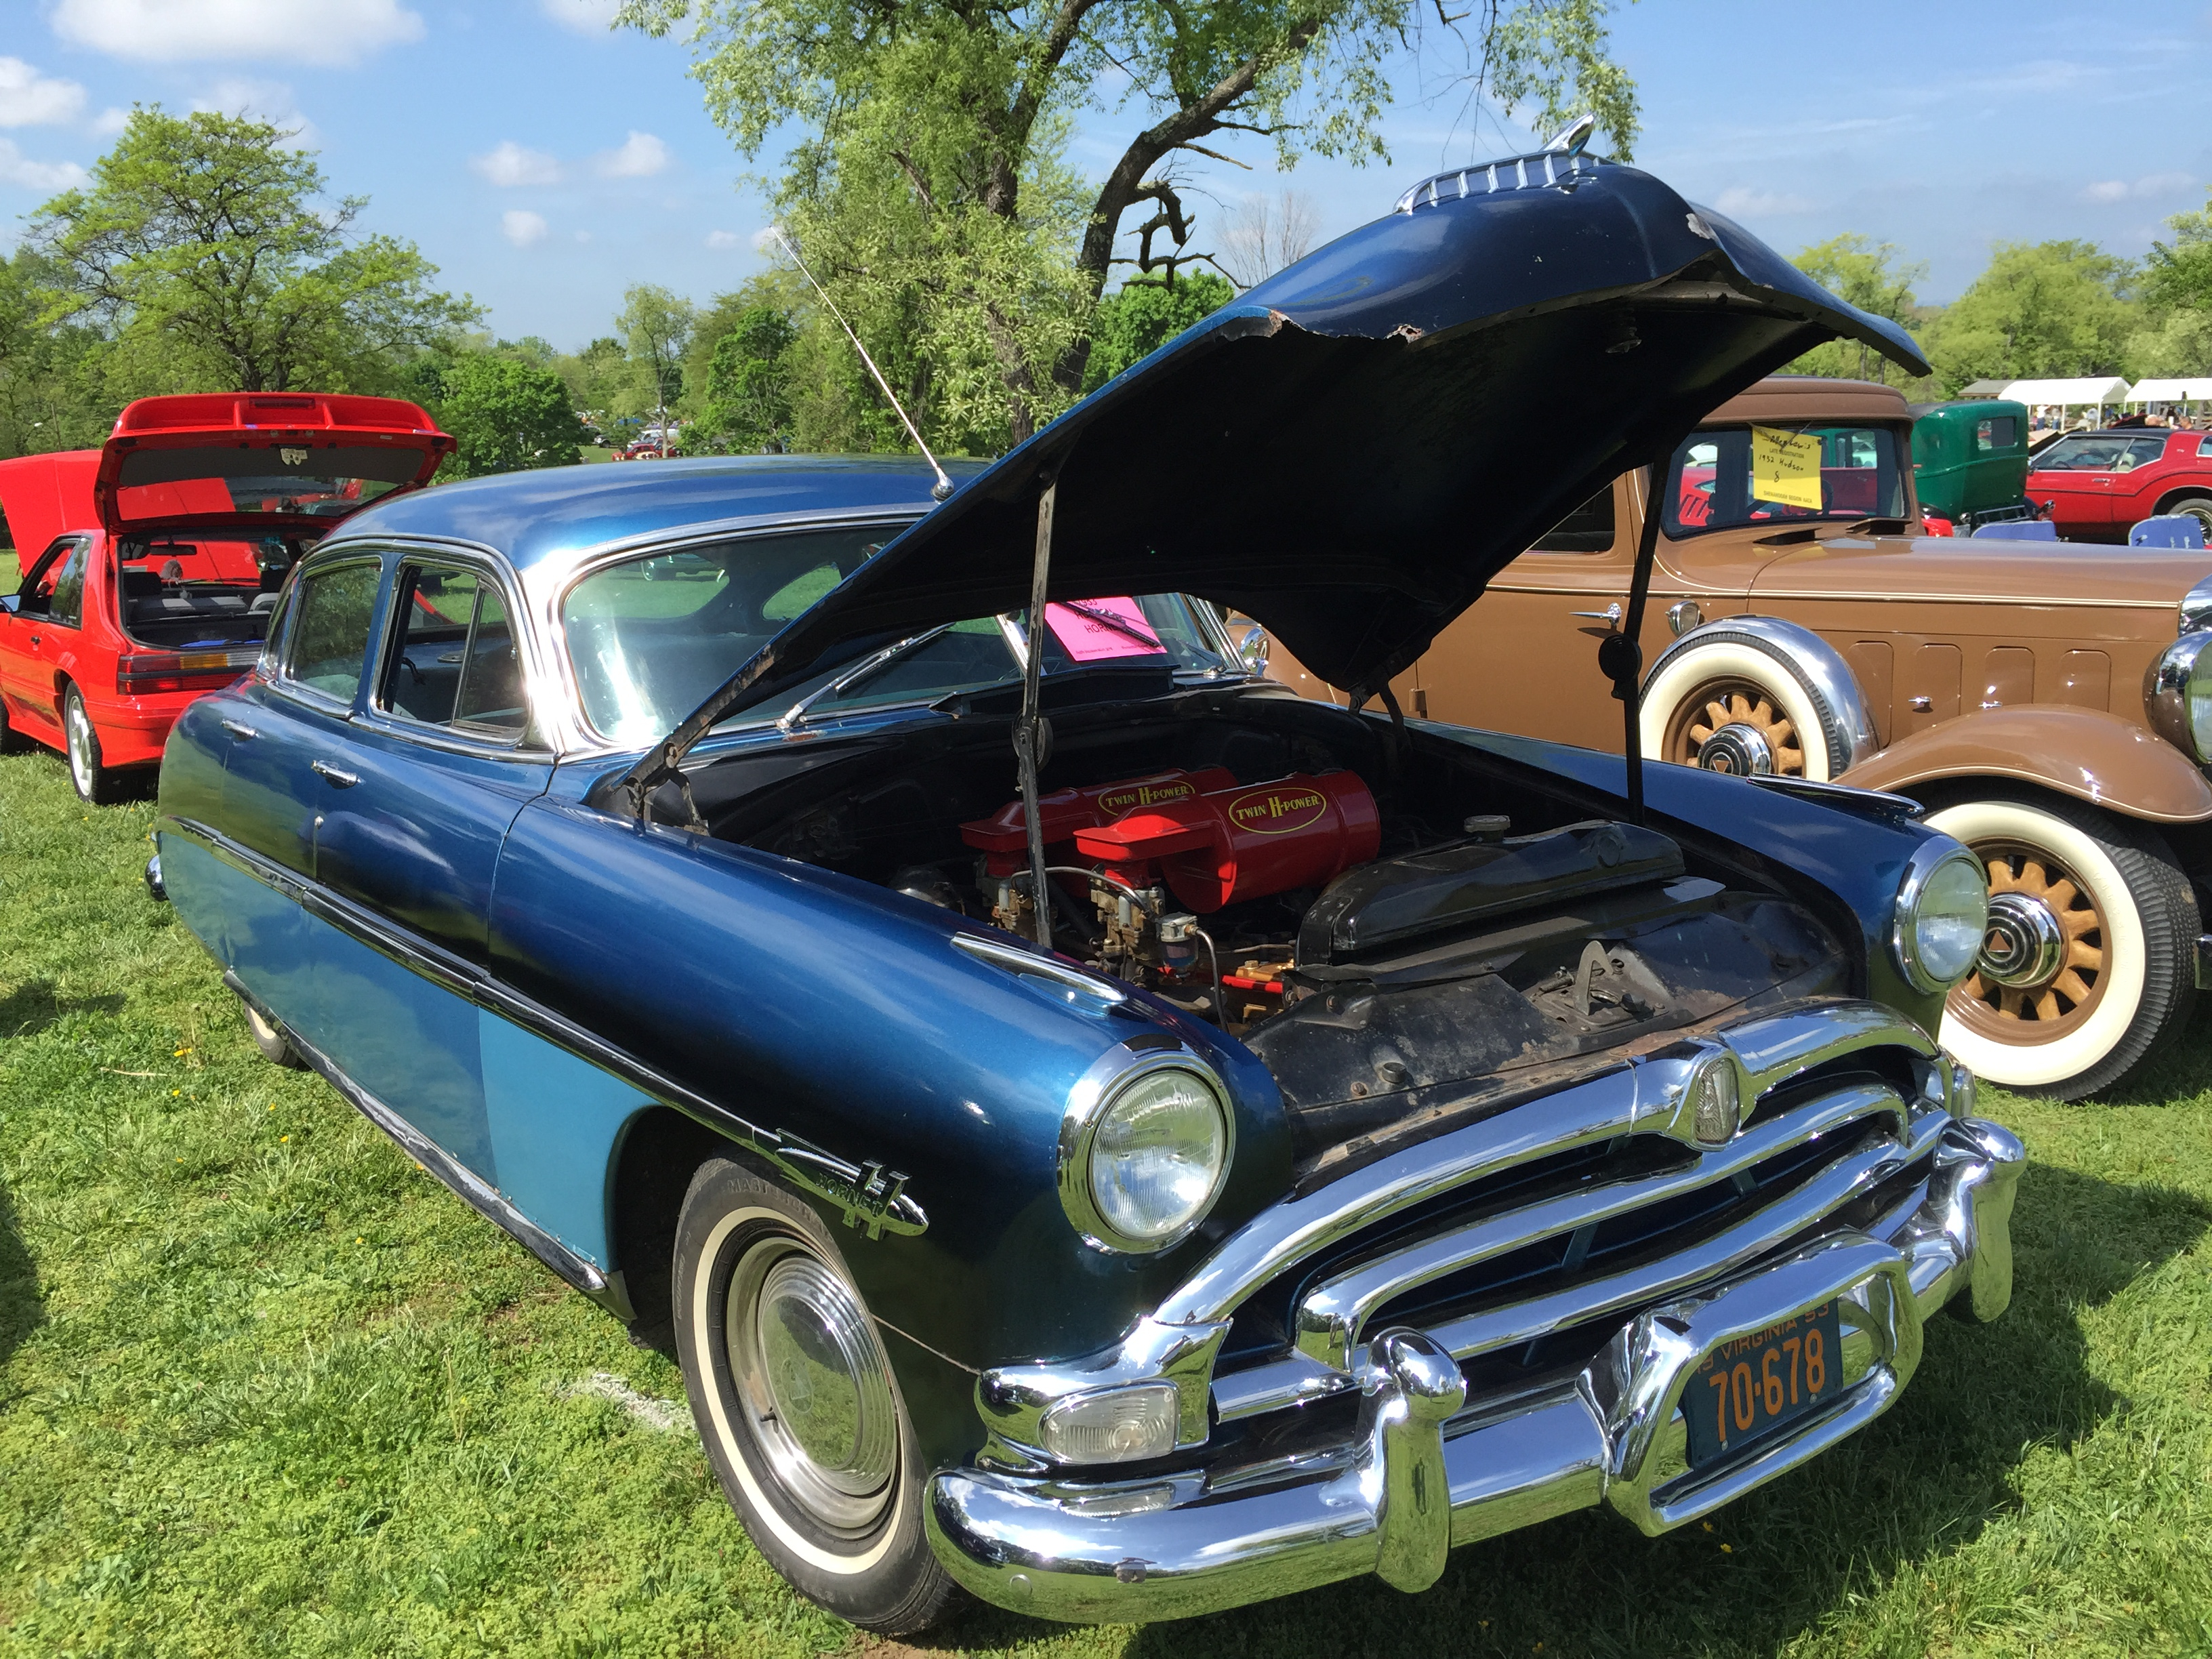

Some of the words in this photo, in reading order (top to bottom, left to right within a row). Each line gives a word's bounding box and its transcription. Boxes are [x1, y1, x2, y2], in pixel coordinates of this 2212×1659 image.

[1759, 454, 1774, 463] 1932
[1779, 457, 1804, 471] Hudson
[1105, 794, 1136, 807] TWIN
[1138, 785, 1189, 806] H-POWER
[1236, 804, 1267, 821] TWIN
[1267, 795, 1320, 819] H-POWER
[816, 1172, 883, 1218] HORNET
[1720, 1319, 1797, 1361] VIRGINIA
